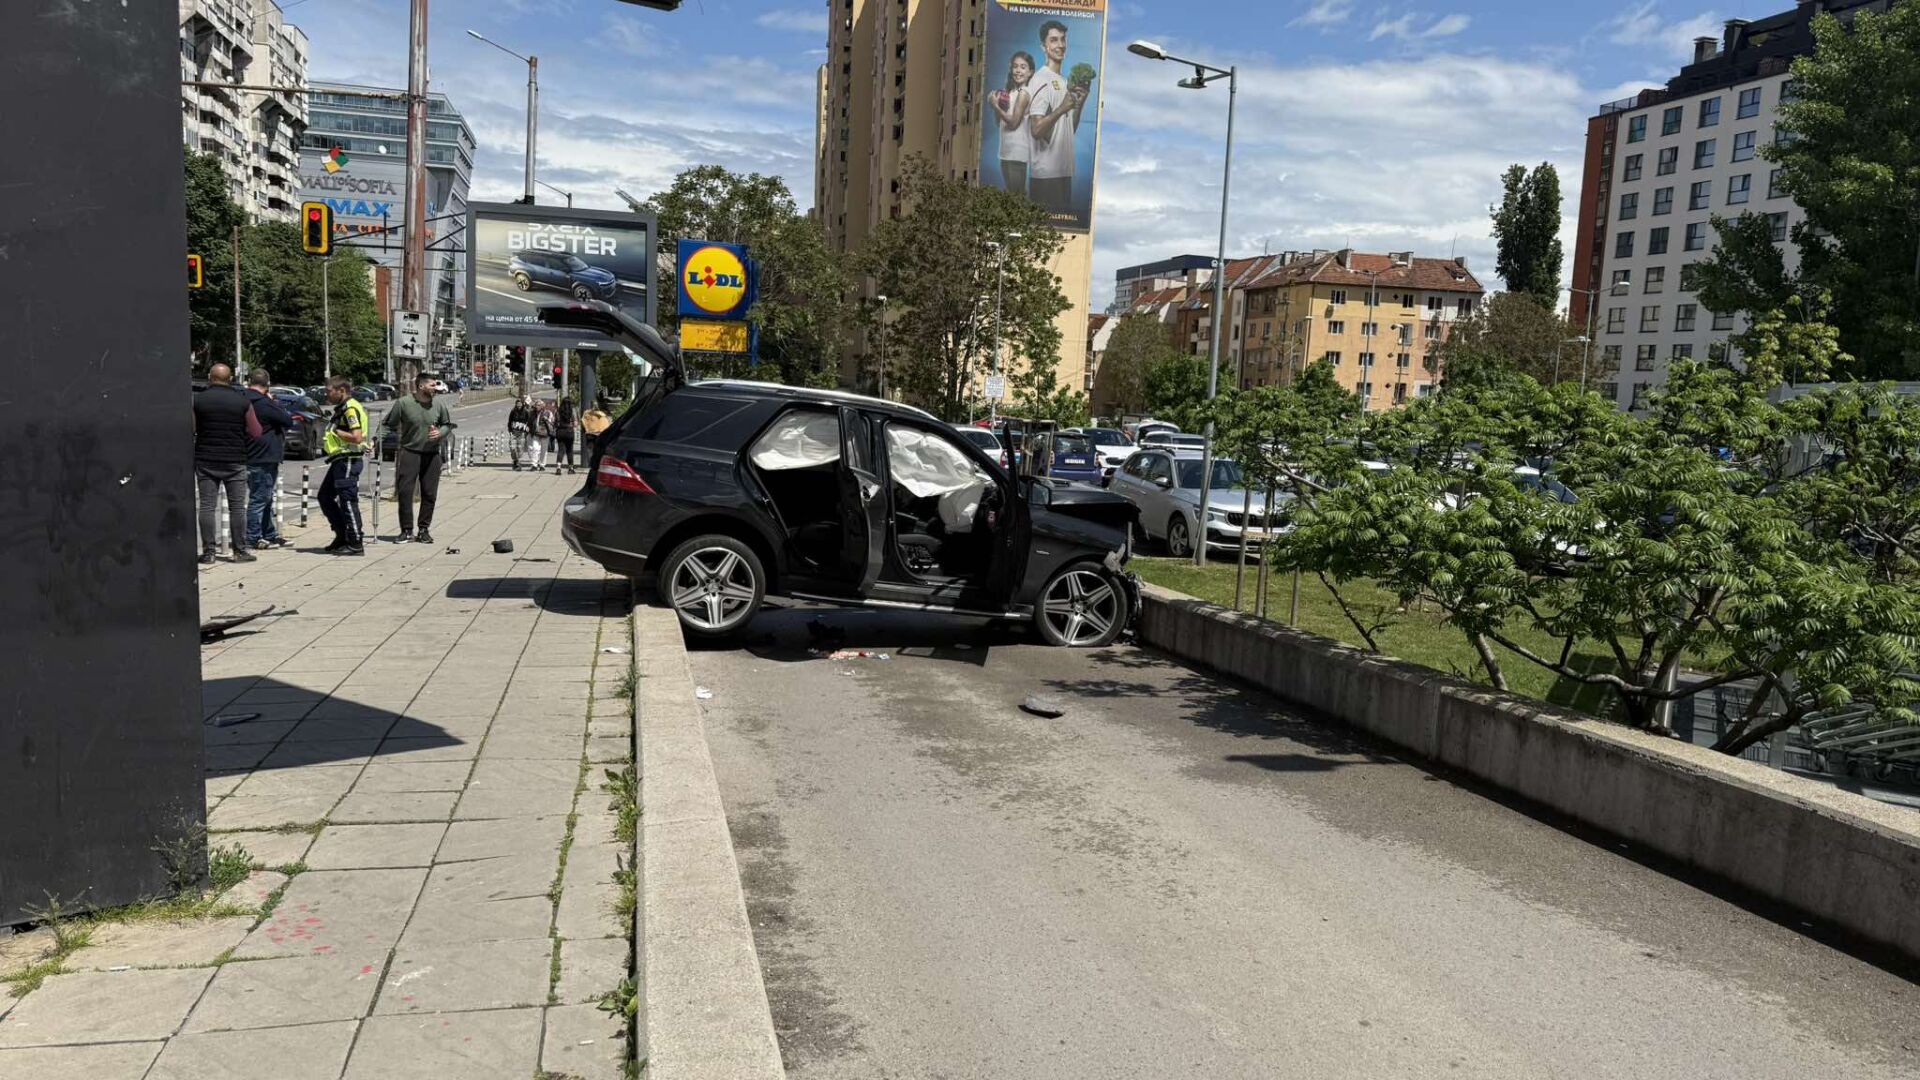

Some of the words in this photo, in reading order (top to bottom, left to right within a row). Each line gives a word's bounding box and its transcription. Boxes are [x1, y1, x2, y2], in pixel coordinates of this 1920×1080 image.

[348, 178, 397, 195] SOFIA
[321, 198, 390, 217] MAX
[507, 230, 617, 256] BIGSTER
[495, 315, 514, 323] цена
